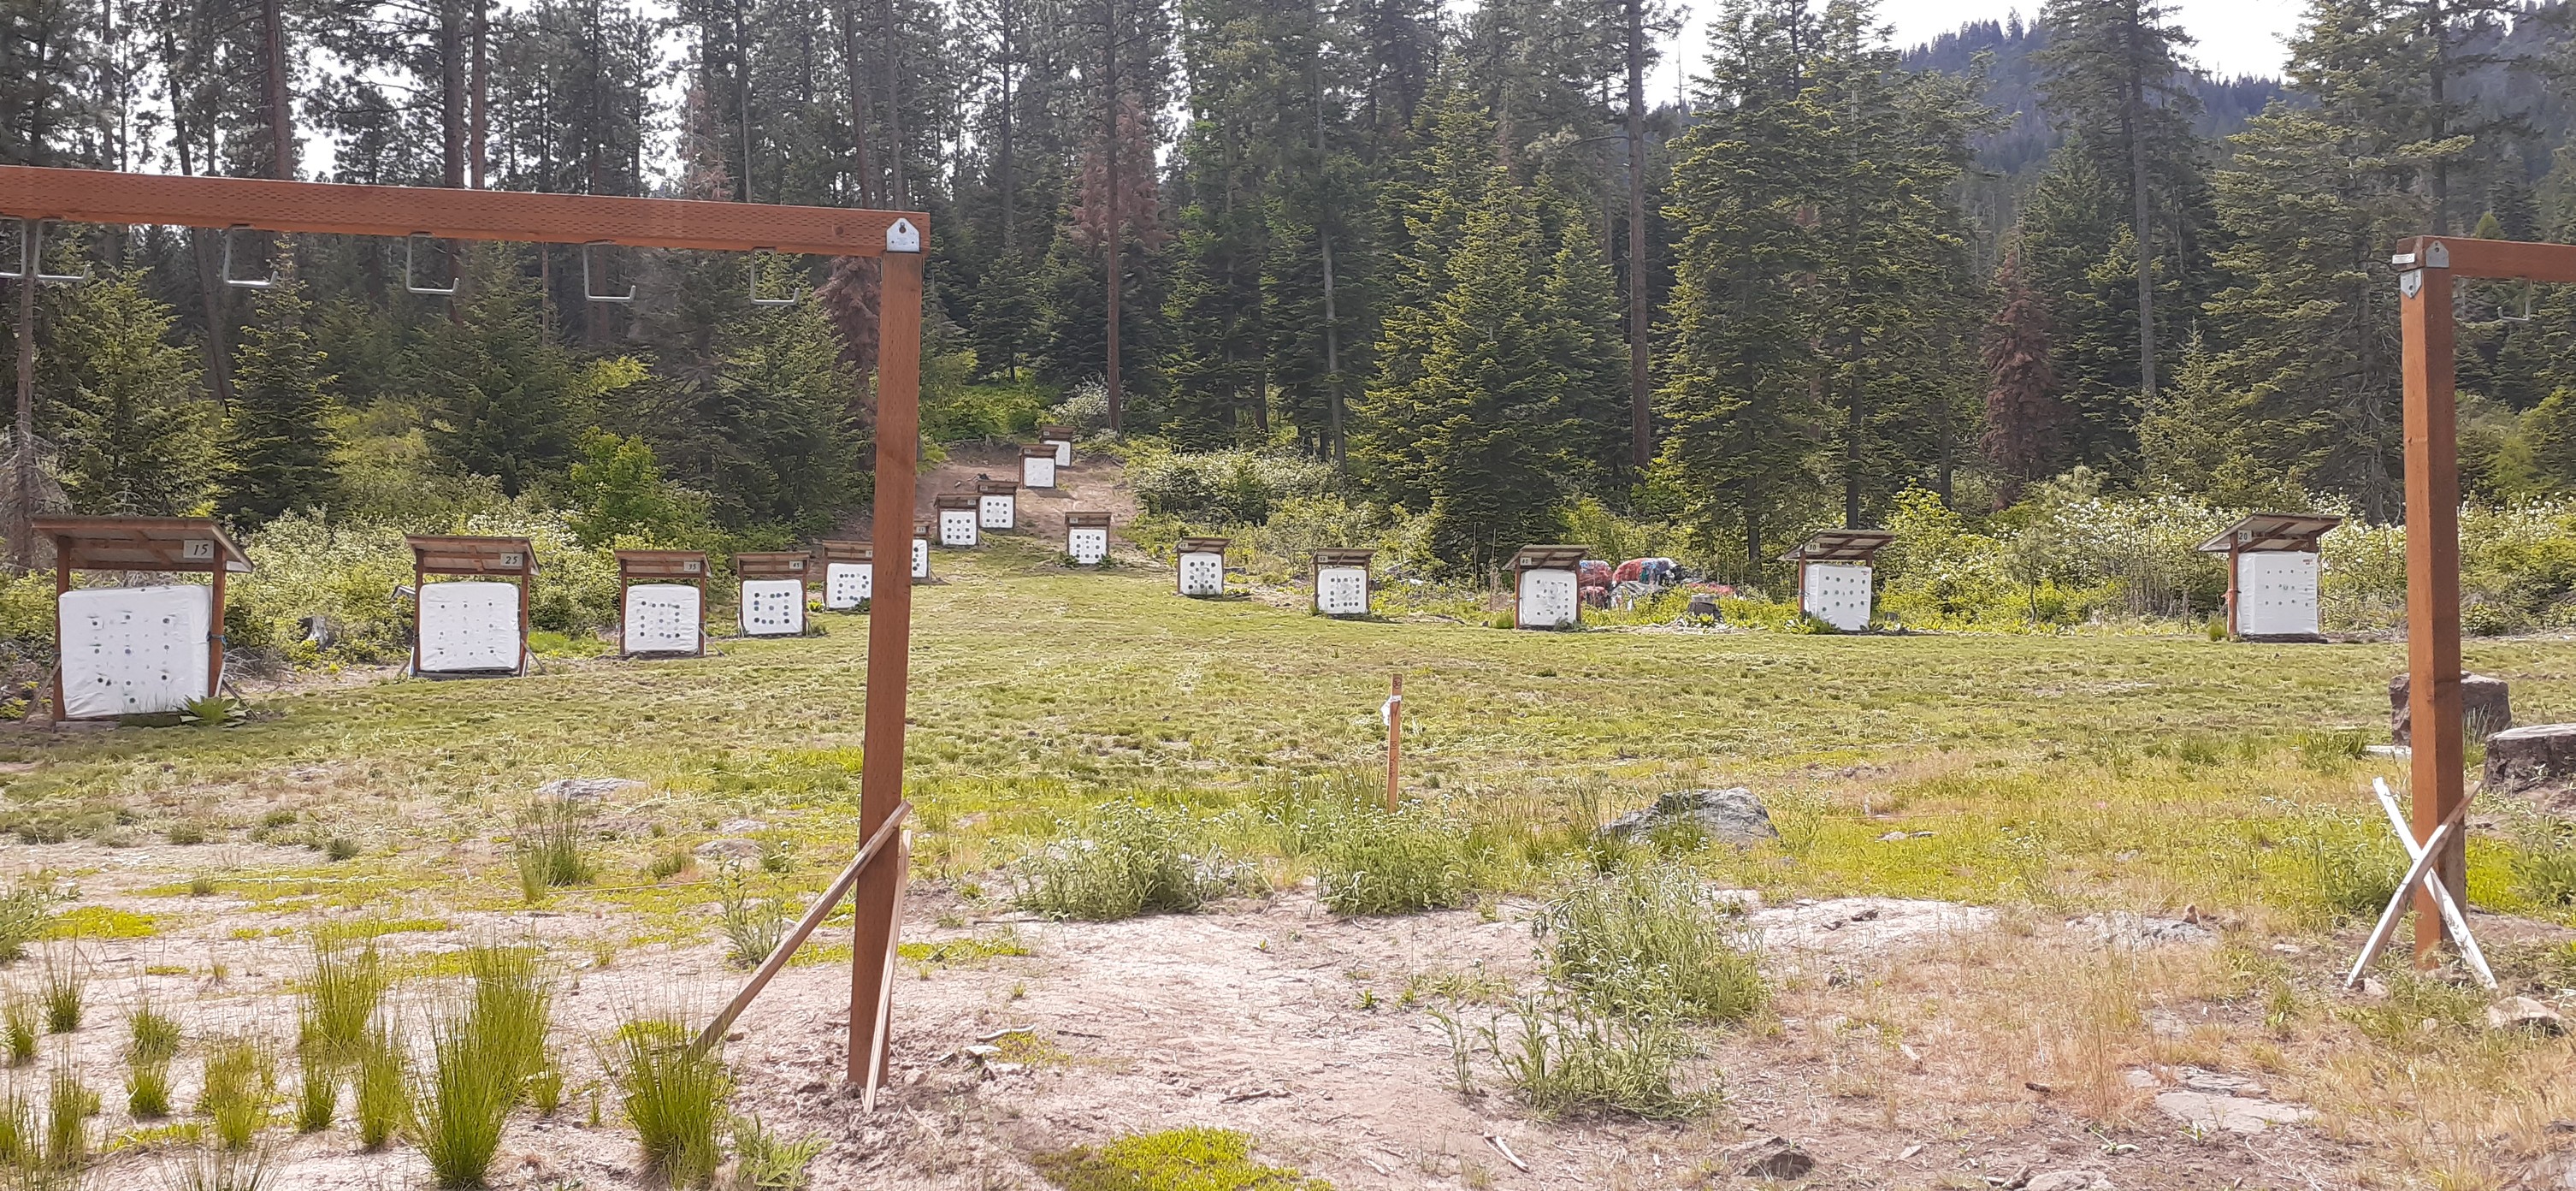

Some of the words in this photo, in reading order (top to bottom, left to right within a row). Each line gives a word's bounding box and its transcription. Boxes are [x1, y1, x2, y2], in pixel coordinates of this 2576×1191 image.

[2238, 532, 2248, 541] 20
[193, 543, 209, 556] 15
[505, 555, 518, 565] 25
